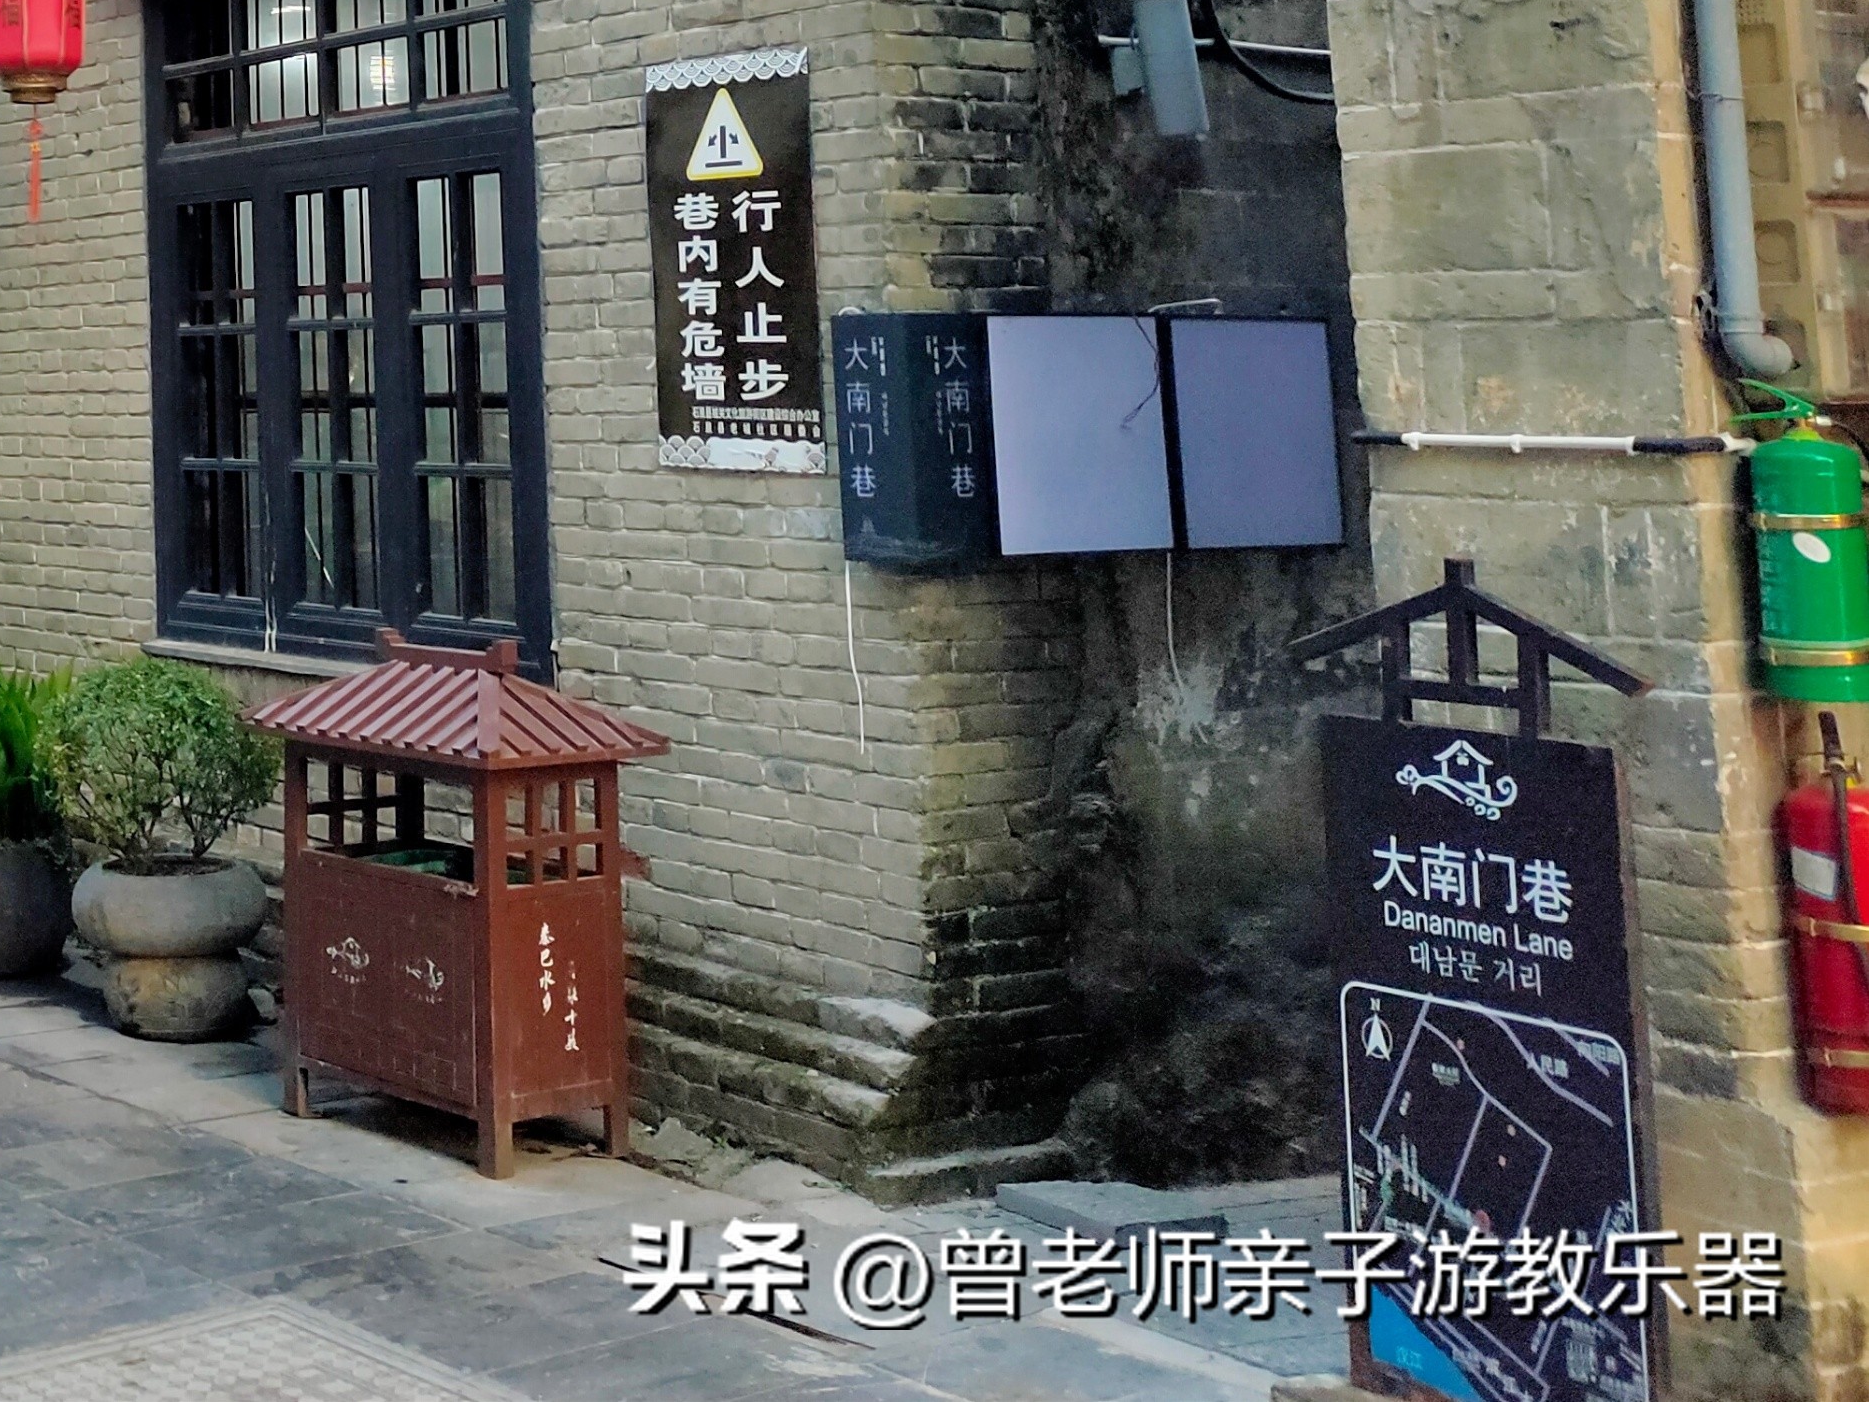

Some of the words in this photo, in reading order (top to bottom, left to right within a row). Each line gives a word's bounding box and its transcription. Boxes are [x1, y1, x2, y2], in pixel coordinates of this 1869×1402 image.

[674, 192, 726, 401] 巷内有危墙
[732, 191, 789, 401] 行人止步
[845, 337, 877, 498] 大南门巷
[944, 337, 976, 498] 大南门巷
[1373, 835, 1573, 924] 大南门巷
[1383, 900, 1507, 948] Dananmen
[1513, 923, 1573, 961] Lane
[1409, 940, 1483, 983] 대남문
[1493, 958, 1542, 997] 거리
